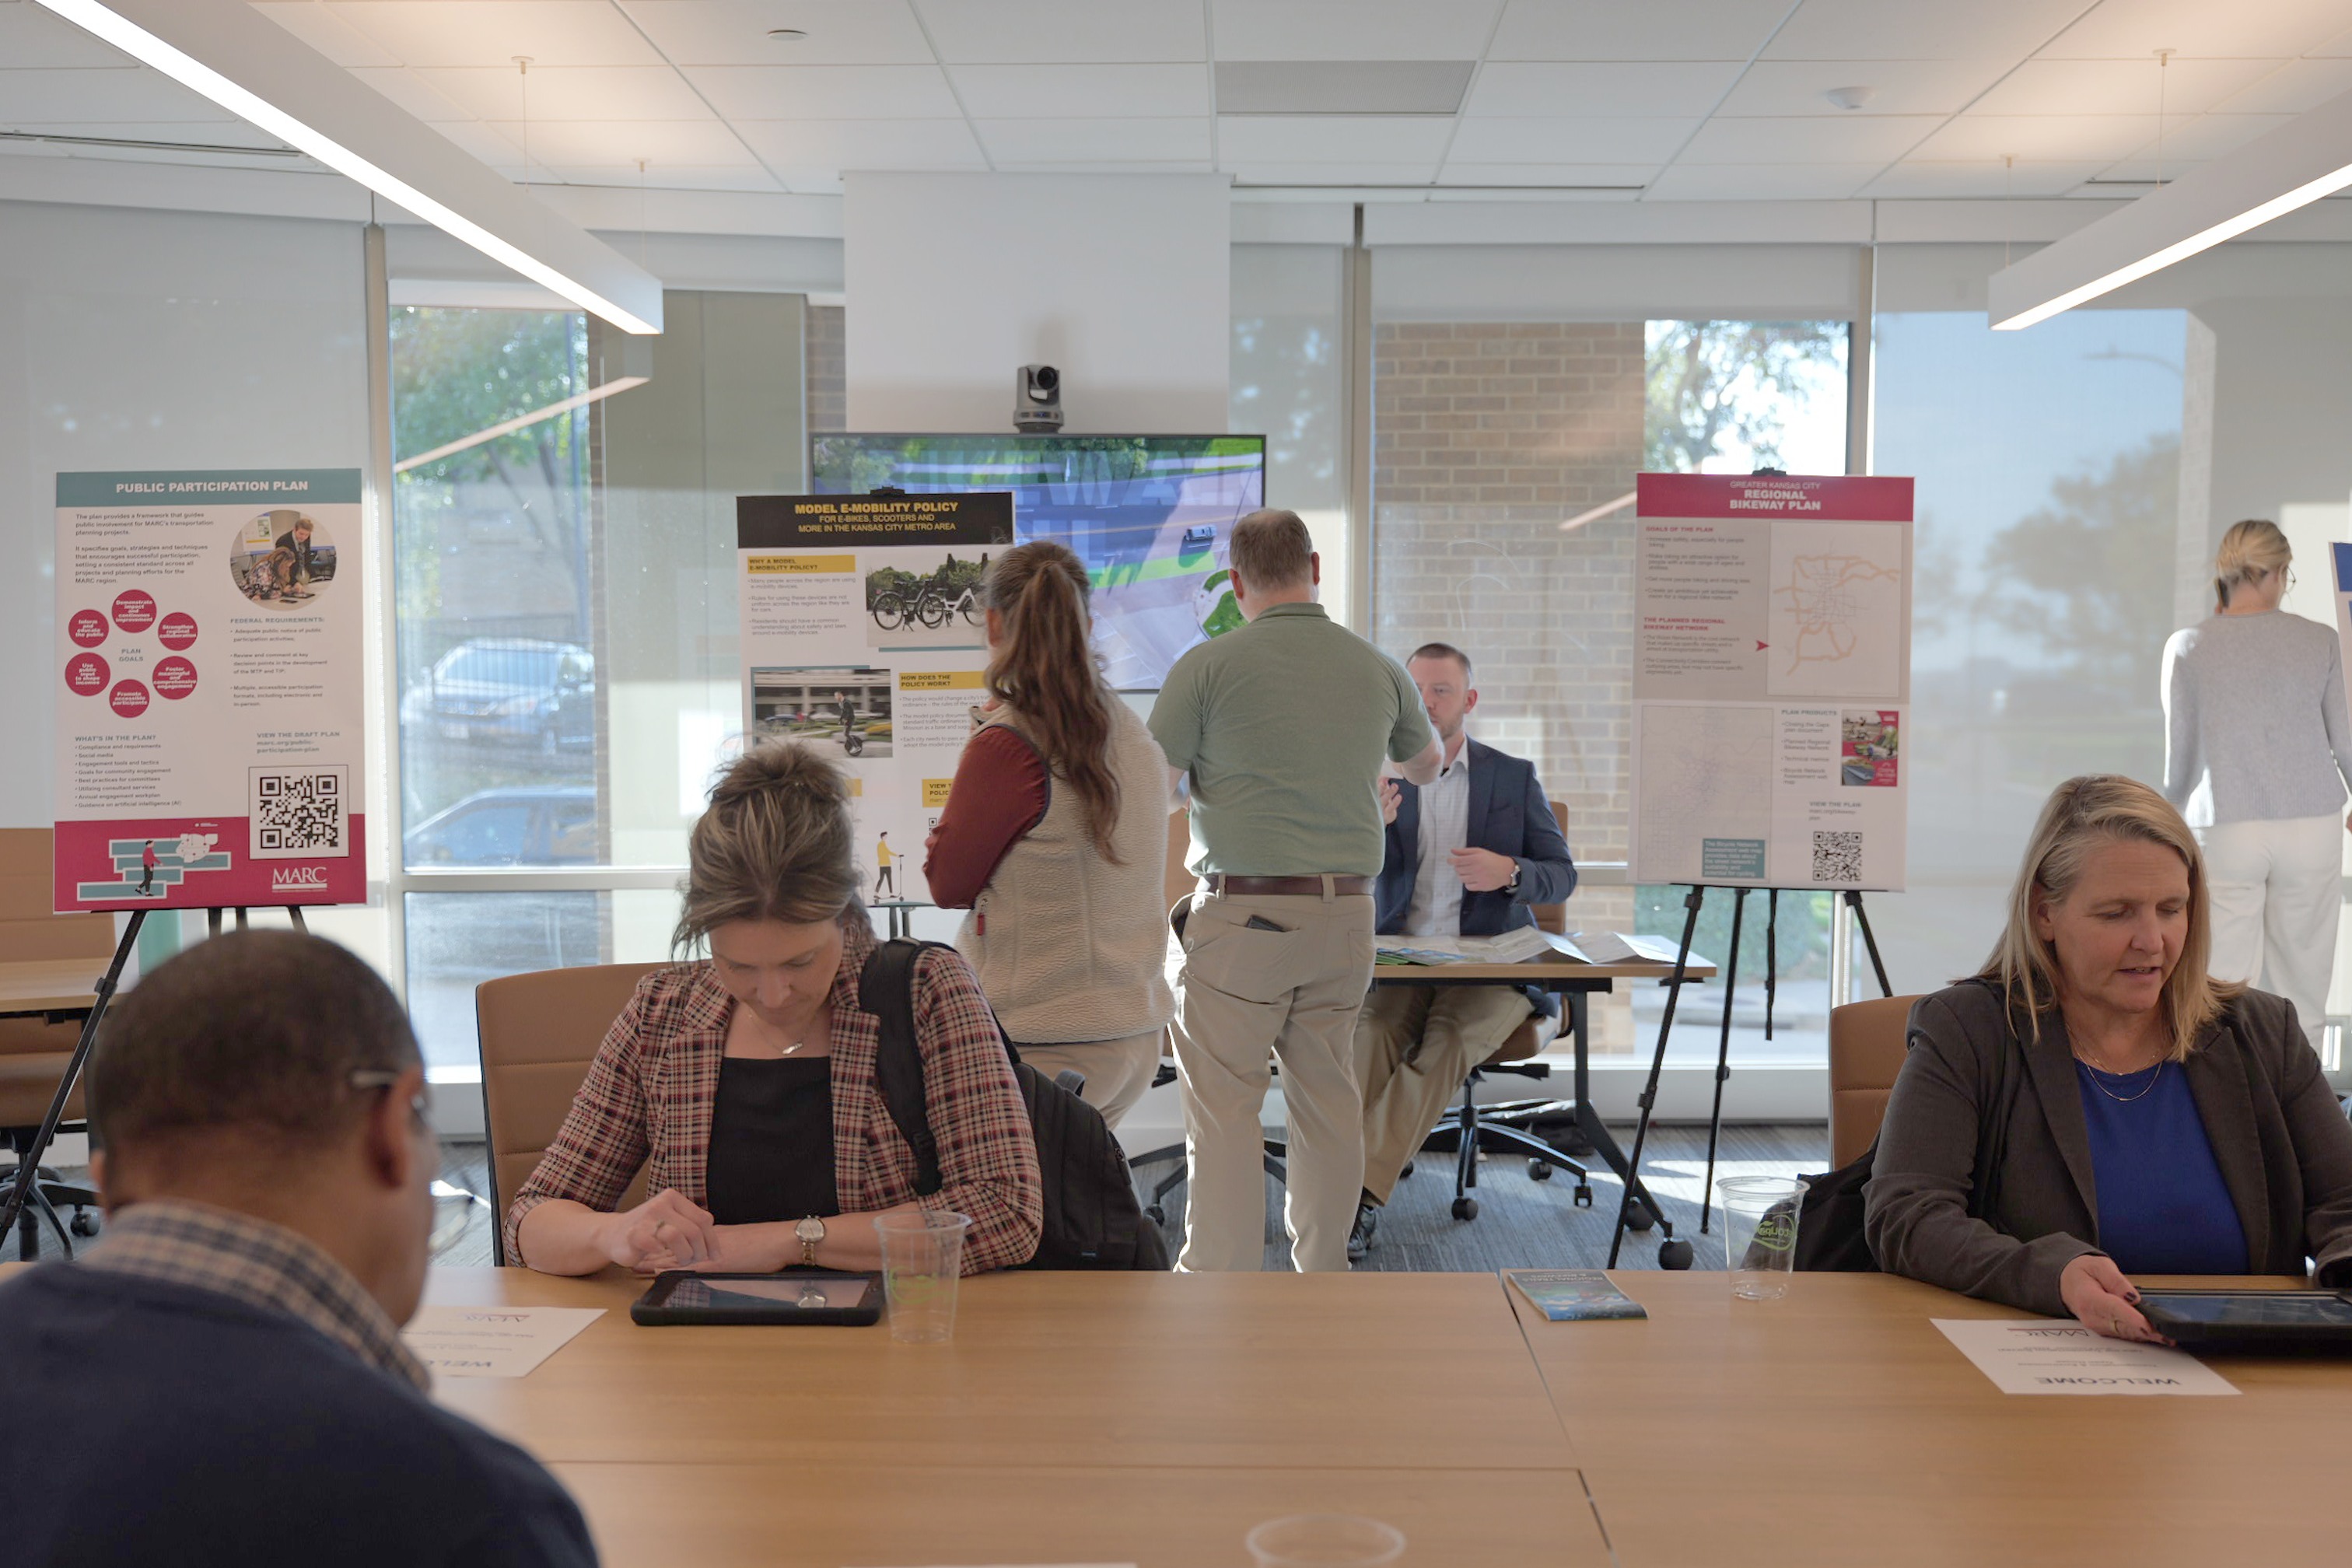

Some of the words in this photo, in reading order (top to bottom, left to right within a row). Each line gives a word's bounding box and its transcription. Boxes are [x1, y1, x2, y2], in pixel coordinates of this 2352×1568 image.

[116, 483, 164, 493] PUBLIC
[169, 482, 269, 492] PARTICIPATION
[273, 481, 308, 492] PLAN
[1745, 490, 1805, 499] REGIONAL
[795, 503, 837, 514] MODEL
[840, 503, 909, 513] E-MOBILITY
[913, 502, 957, 513] POLICY
[1730, 500, 1784, 509] BIKEWAY
[1788, 501, 1821, 510] PLAN
[273, 866, 326, 884] MARC
[2034, 1377, 2181, 1385] WELCOME
